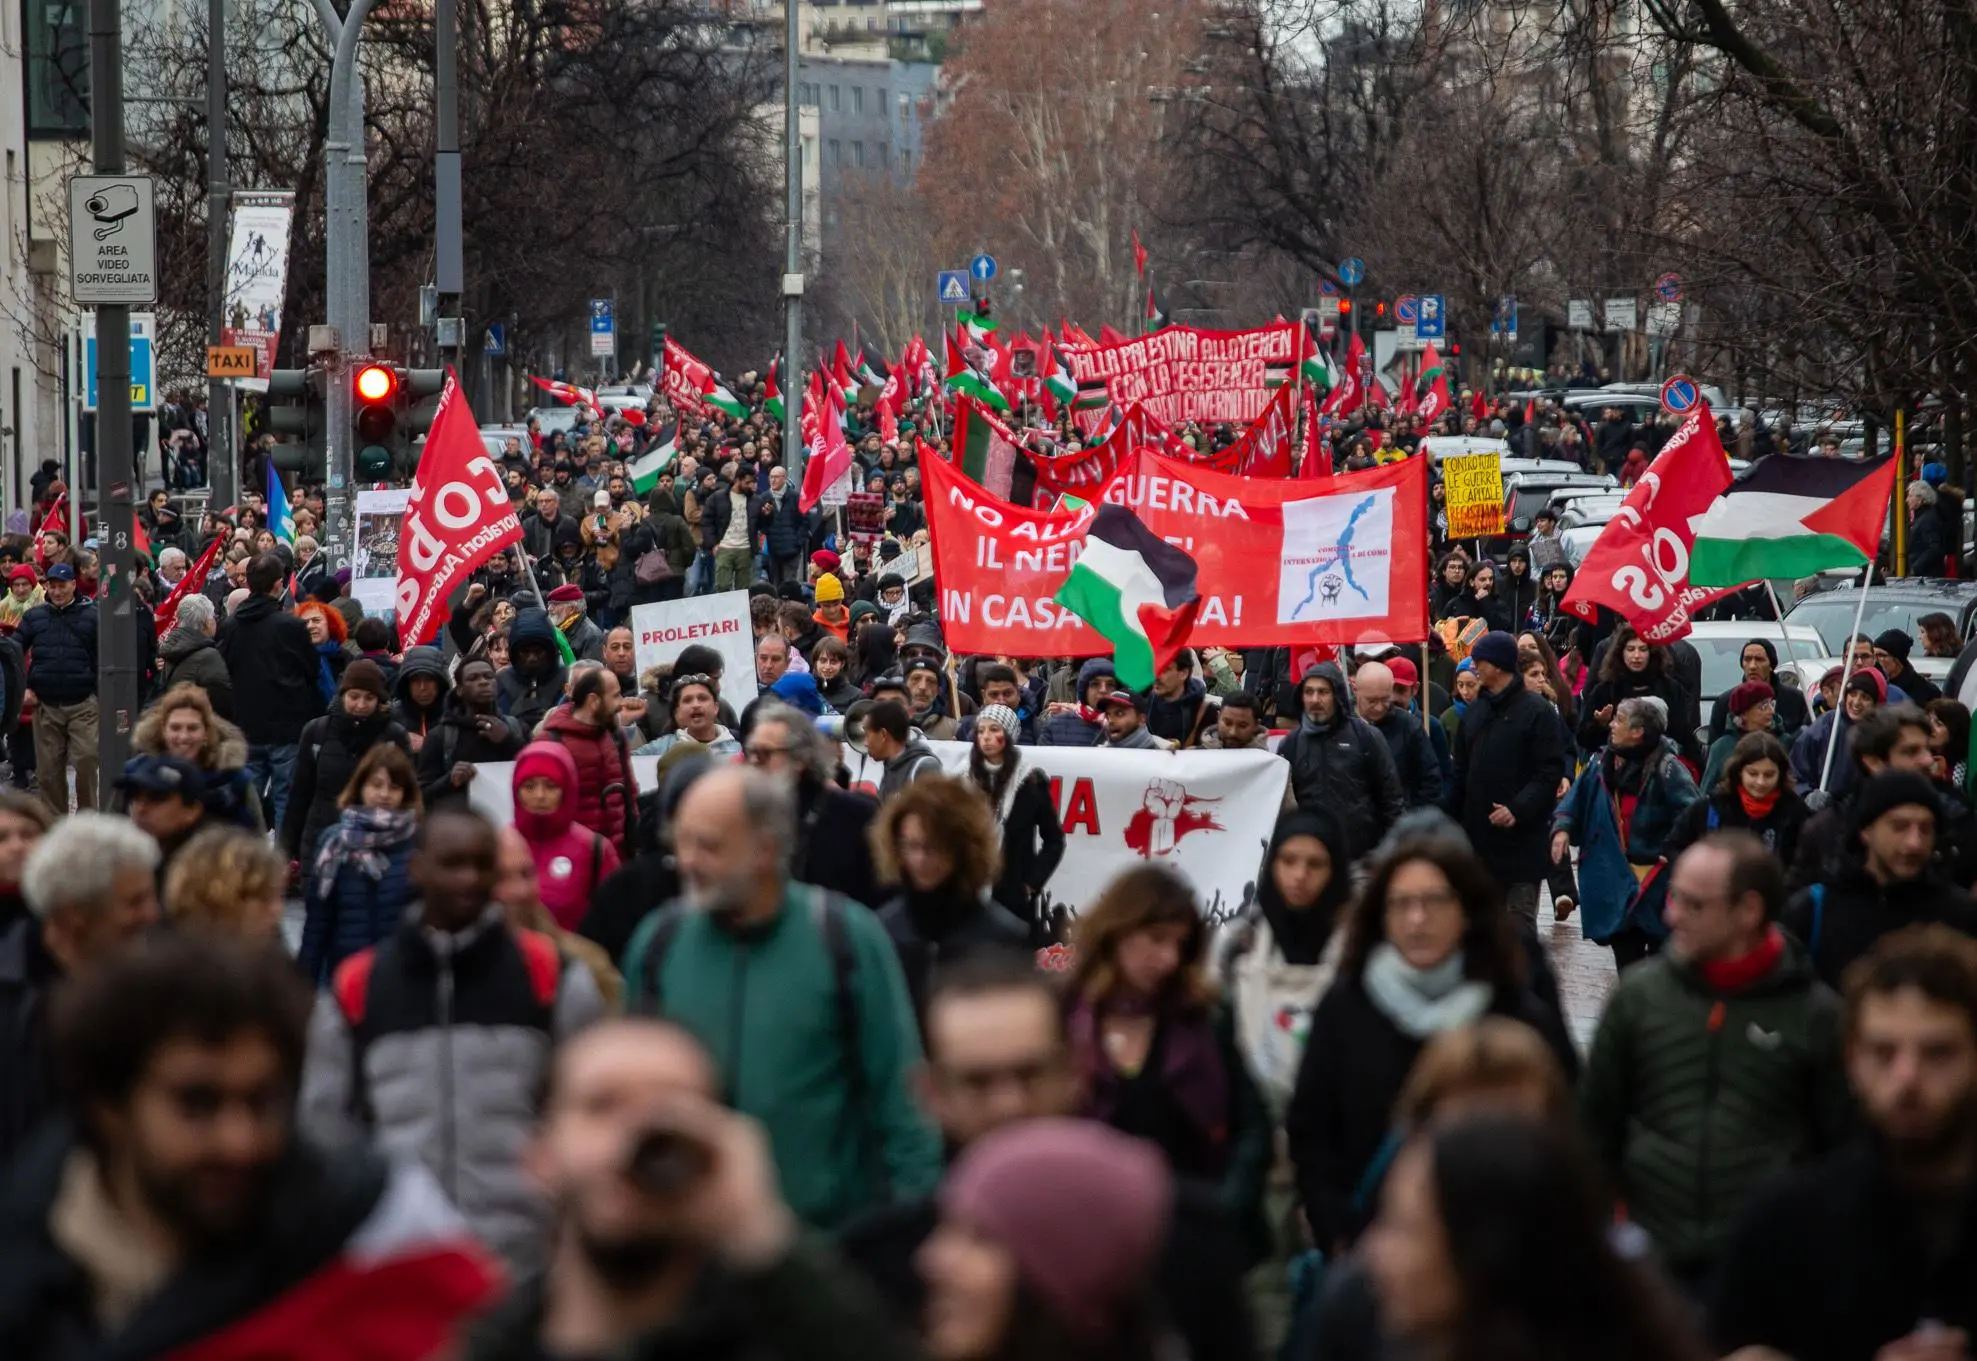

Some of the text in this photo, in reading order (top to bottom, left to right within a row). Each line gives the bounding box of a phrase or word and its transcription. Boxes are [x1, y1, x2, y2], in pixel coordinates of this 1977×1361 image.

[98, 245, 128, 256] AREA
[97, 259, 130, 270] VIDEO
[77, 273, 151, 284] SORVEGLIATA
[1120, 330, 1198, 373] PALESTINA
[1237, 328, 1293, 359] YEMEN
[210, 353, 250, 368] TAXI
[1445, 454, 1498, 473] CONTRO TUTTE
[1448, 471, 1498, 489] LE GUERRE
[950, 485, 1003, 527] NO
[1103, 474, 1250, 520] GUERRA
[1463, 486, 1501, 503] CAPITALE
[977, 535, 1004, 569] IL
[944, 588, 971, 624] IN
[982, 594, 1083, 629] CASA
[642, 618, 740, 645] PROLETARI
